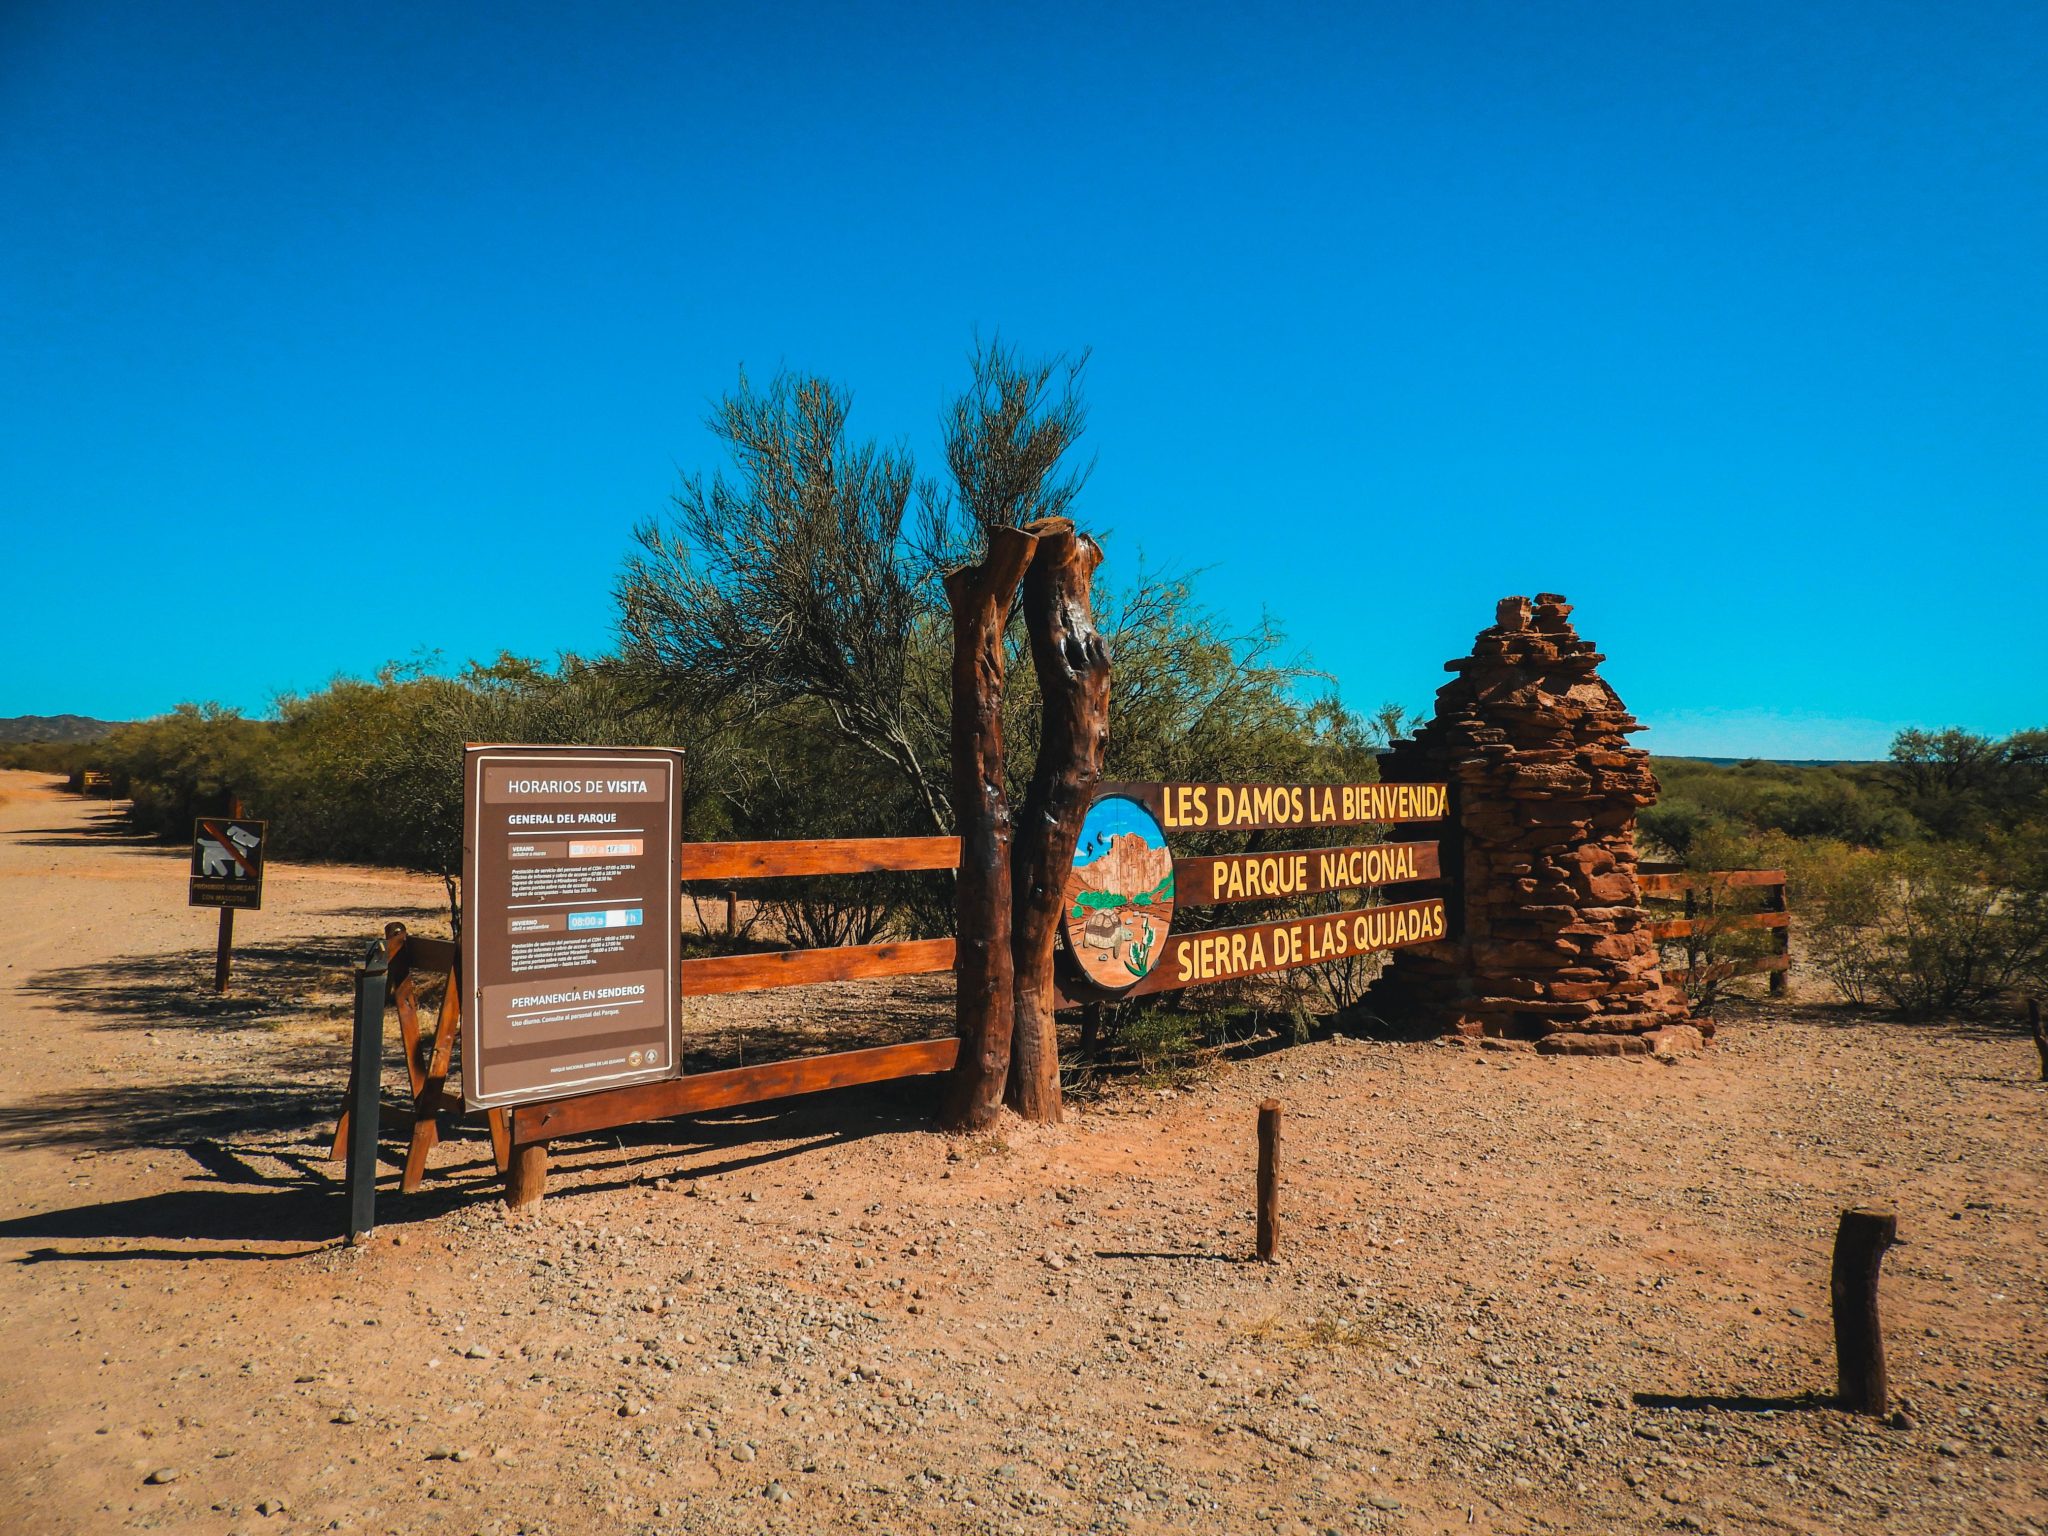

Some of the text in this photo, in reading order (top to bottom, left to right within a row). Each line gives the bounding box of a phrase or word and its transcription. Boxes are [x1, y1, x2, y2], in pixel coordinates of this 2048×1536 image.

[508, 780, 648, 793] HORARIOS DE VISITA
[1163, 786, 1450, 827] LES DAMOS LA BIENVENIDA
[508, 813, 617, 825] GENERAL DEL PARQUE
[1213, 847, 1418, 899] PARQUE NACIONAL
[572, 914, 636, 927] 08:00 a h
[1177, 905, 1443, 982] SIERRA DE LAS QUIJADAS
[512, 985, 645, 1008] PERMANENCIA EN SENDEROS
[542, 1014, 564, 1023] Consulte
[571, 1011, 592, 1021] personal
